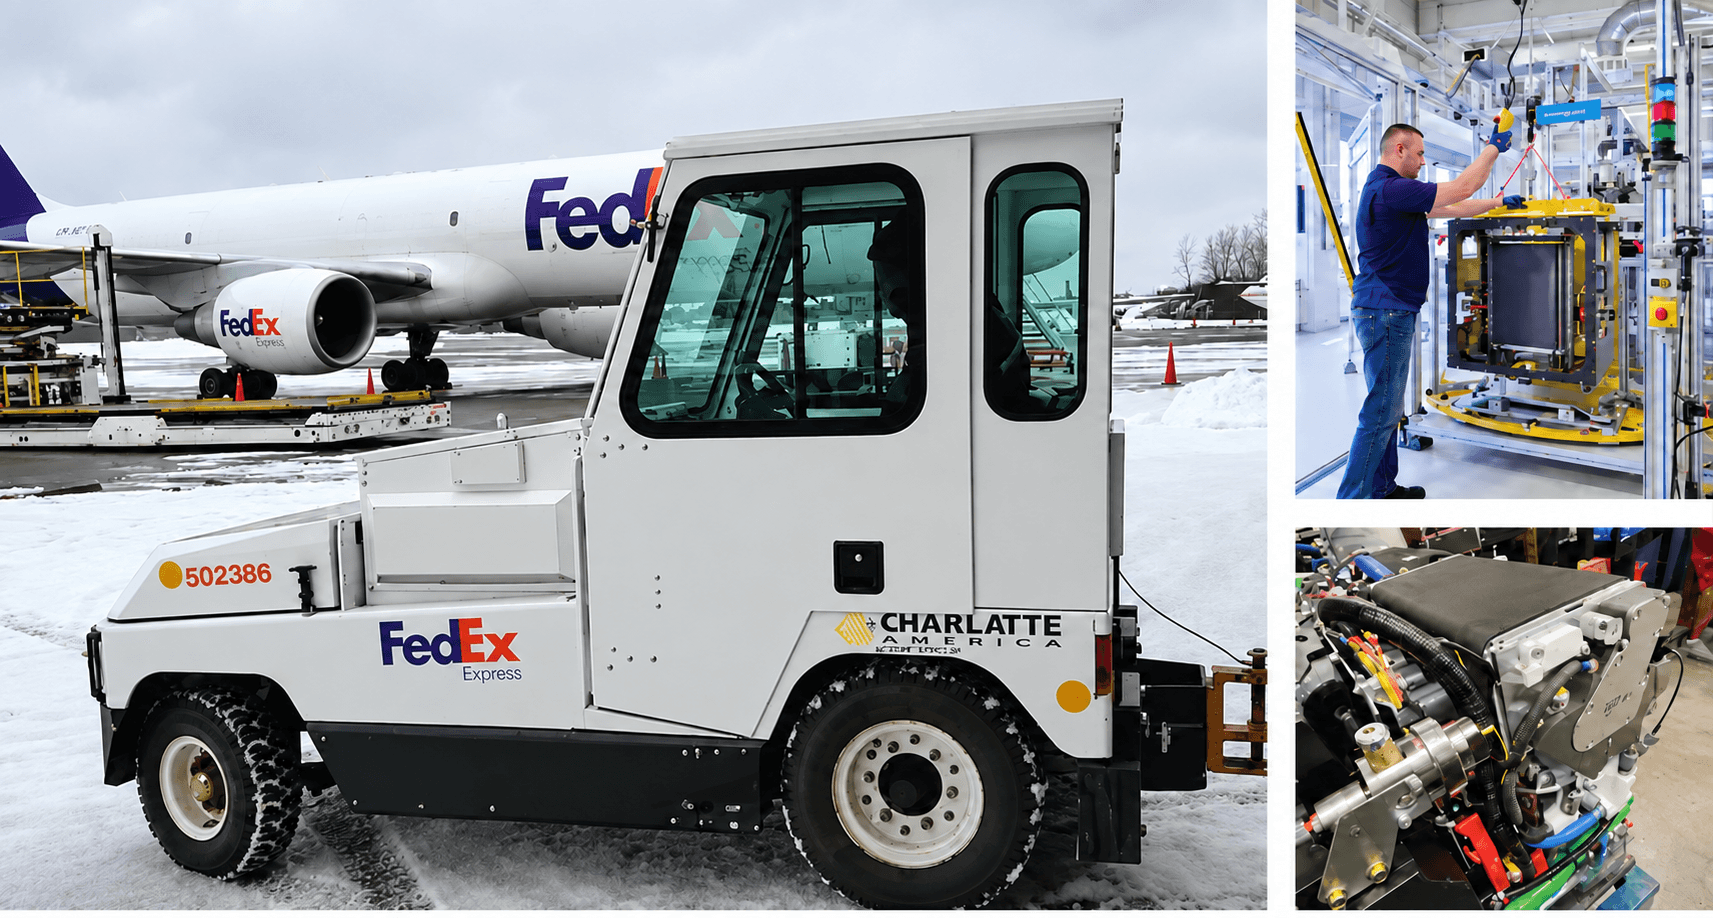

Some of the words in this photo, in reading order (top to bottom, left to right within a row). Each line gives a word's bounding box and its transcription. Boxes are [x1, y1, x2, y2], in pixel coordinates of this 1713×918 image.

[220, 308, 282, 337] FedEx
[255, 337, 285, 349] Express
[185, 563, 272, 588] 502386
[880, 612, 1062, 636] CHARLATTE
[379, 617, 521, 666] FedEx
[882, 635, 1062, 648] AMERICA
[462, 666, 522, 684] Express
